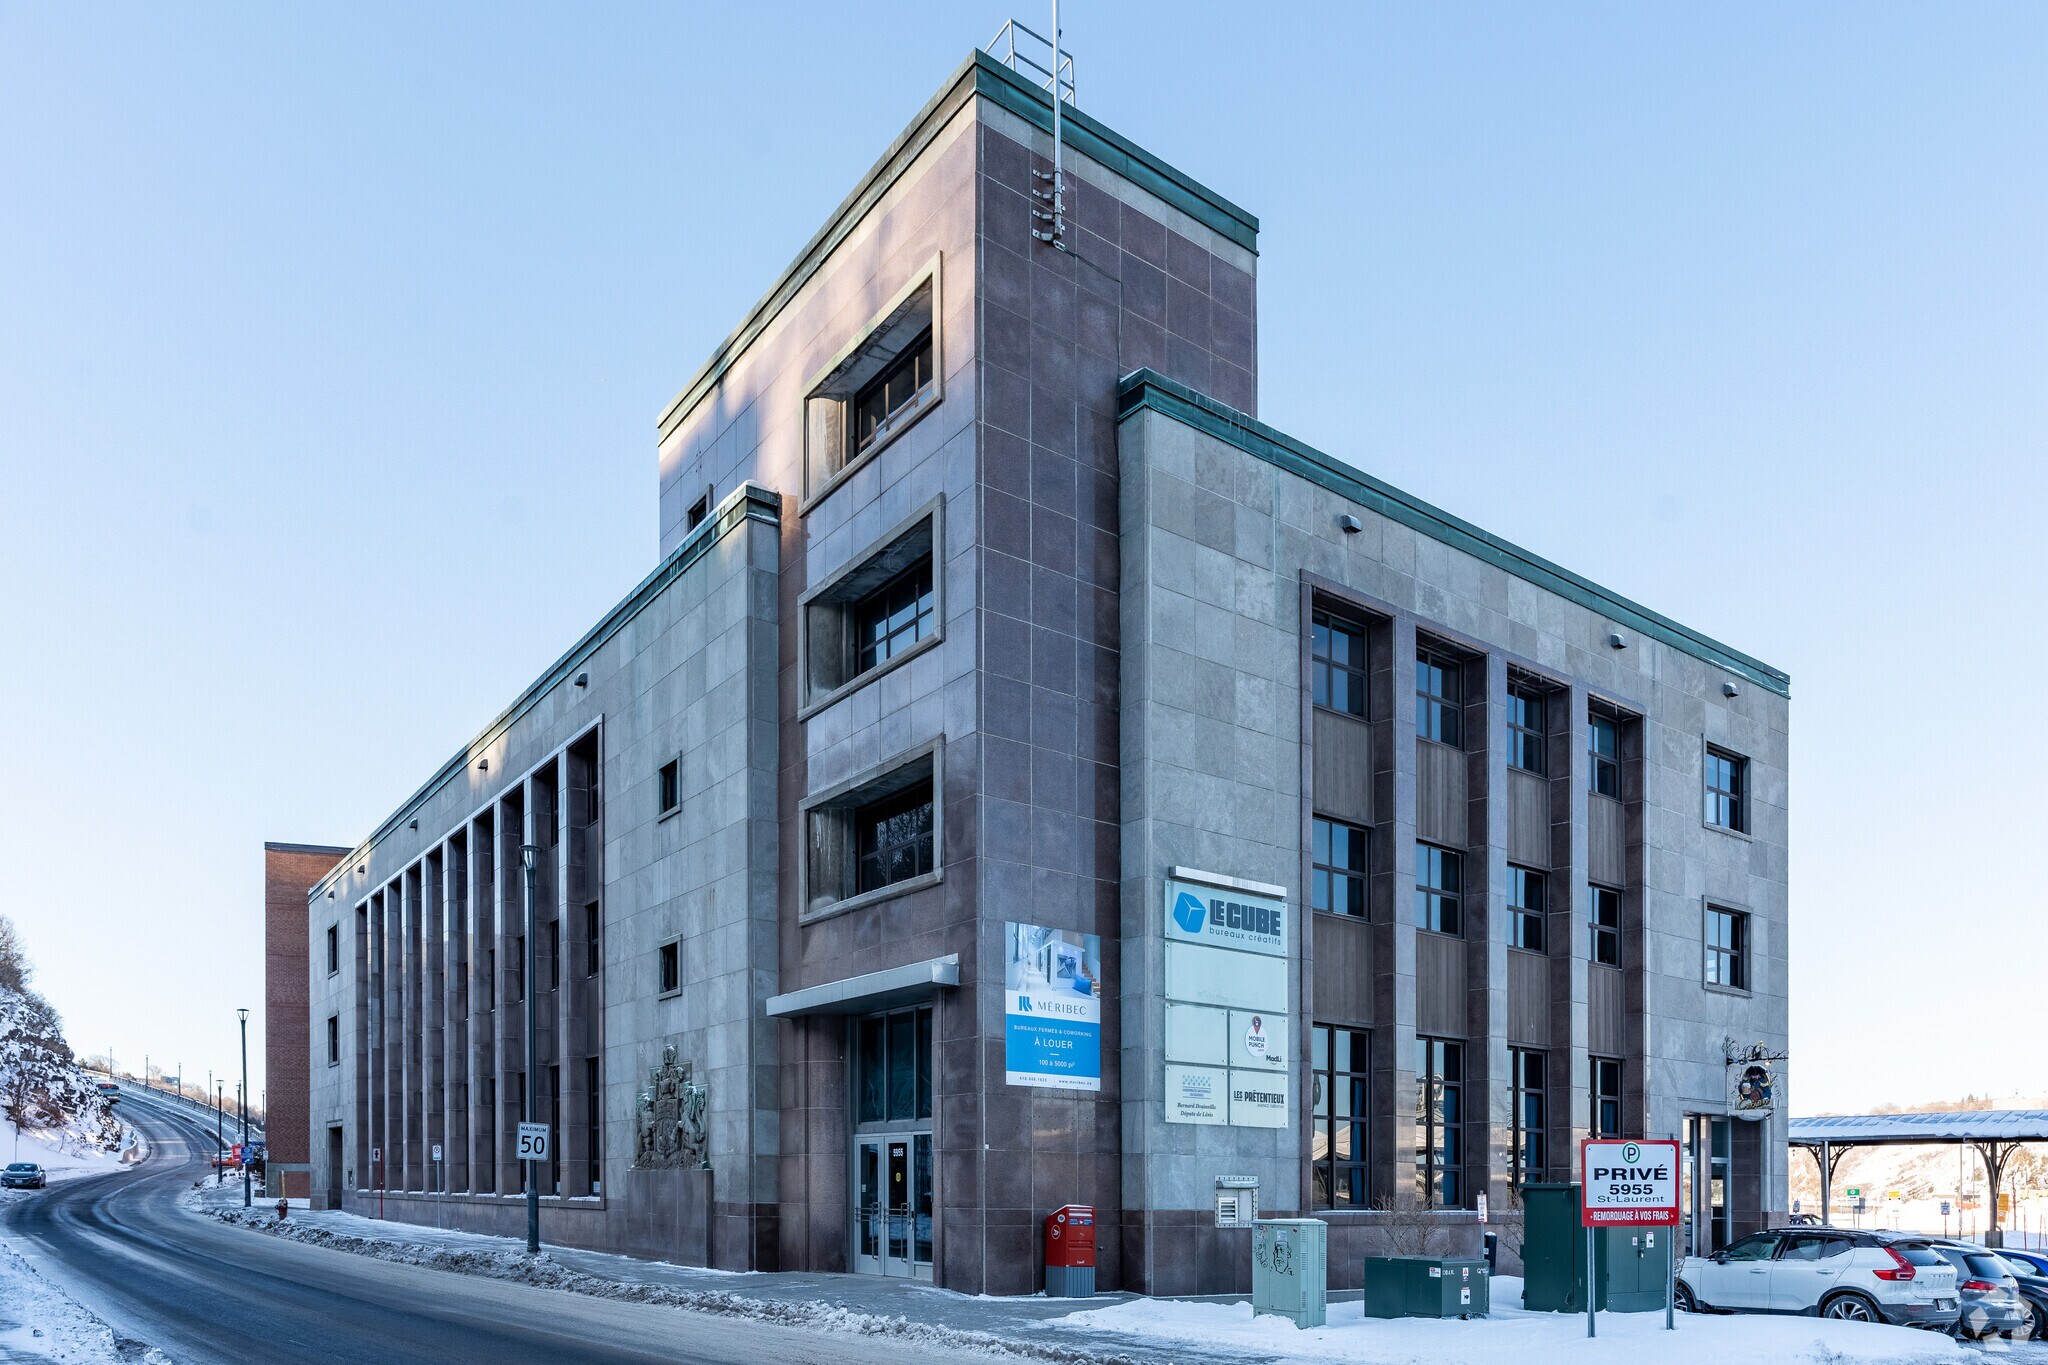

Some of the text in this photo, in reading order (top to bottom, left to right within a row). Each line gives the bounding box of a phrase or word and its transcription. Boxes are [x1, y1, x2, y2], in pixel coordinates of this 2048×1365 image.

[1209, 926, 1282, 946] bureaux créatifs
[1037, 1001, 1087, 1016] MÉRIBEC
[1013, 1024, 1038, 1032] BUREAUX
[1063, 1029, 1093, 1038] COWORKING
[1034, 1036, 1074, 1049] À LOUER
[1248, 1035, 1266, 1043] MOBILE
[1054, 1060, 1068, 1068] 5000
[1233, 1090, 1243, 1099] LES
[520, 1125, 547, 1133] MAXIMUM
[520, 1135, 545, 1155] 50
[1593, 1163, 1668, 1181] PRIVÉ
[1608, 1183, 1654, 1195] 5955
[1597, 1195, 1665, 1203] St-Laurent
[1592, 1209, 1669, 1220] REMORQUAGE À VOS FRAIS
